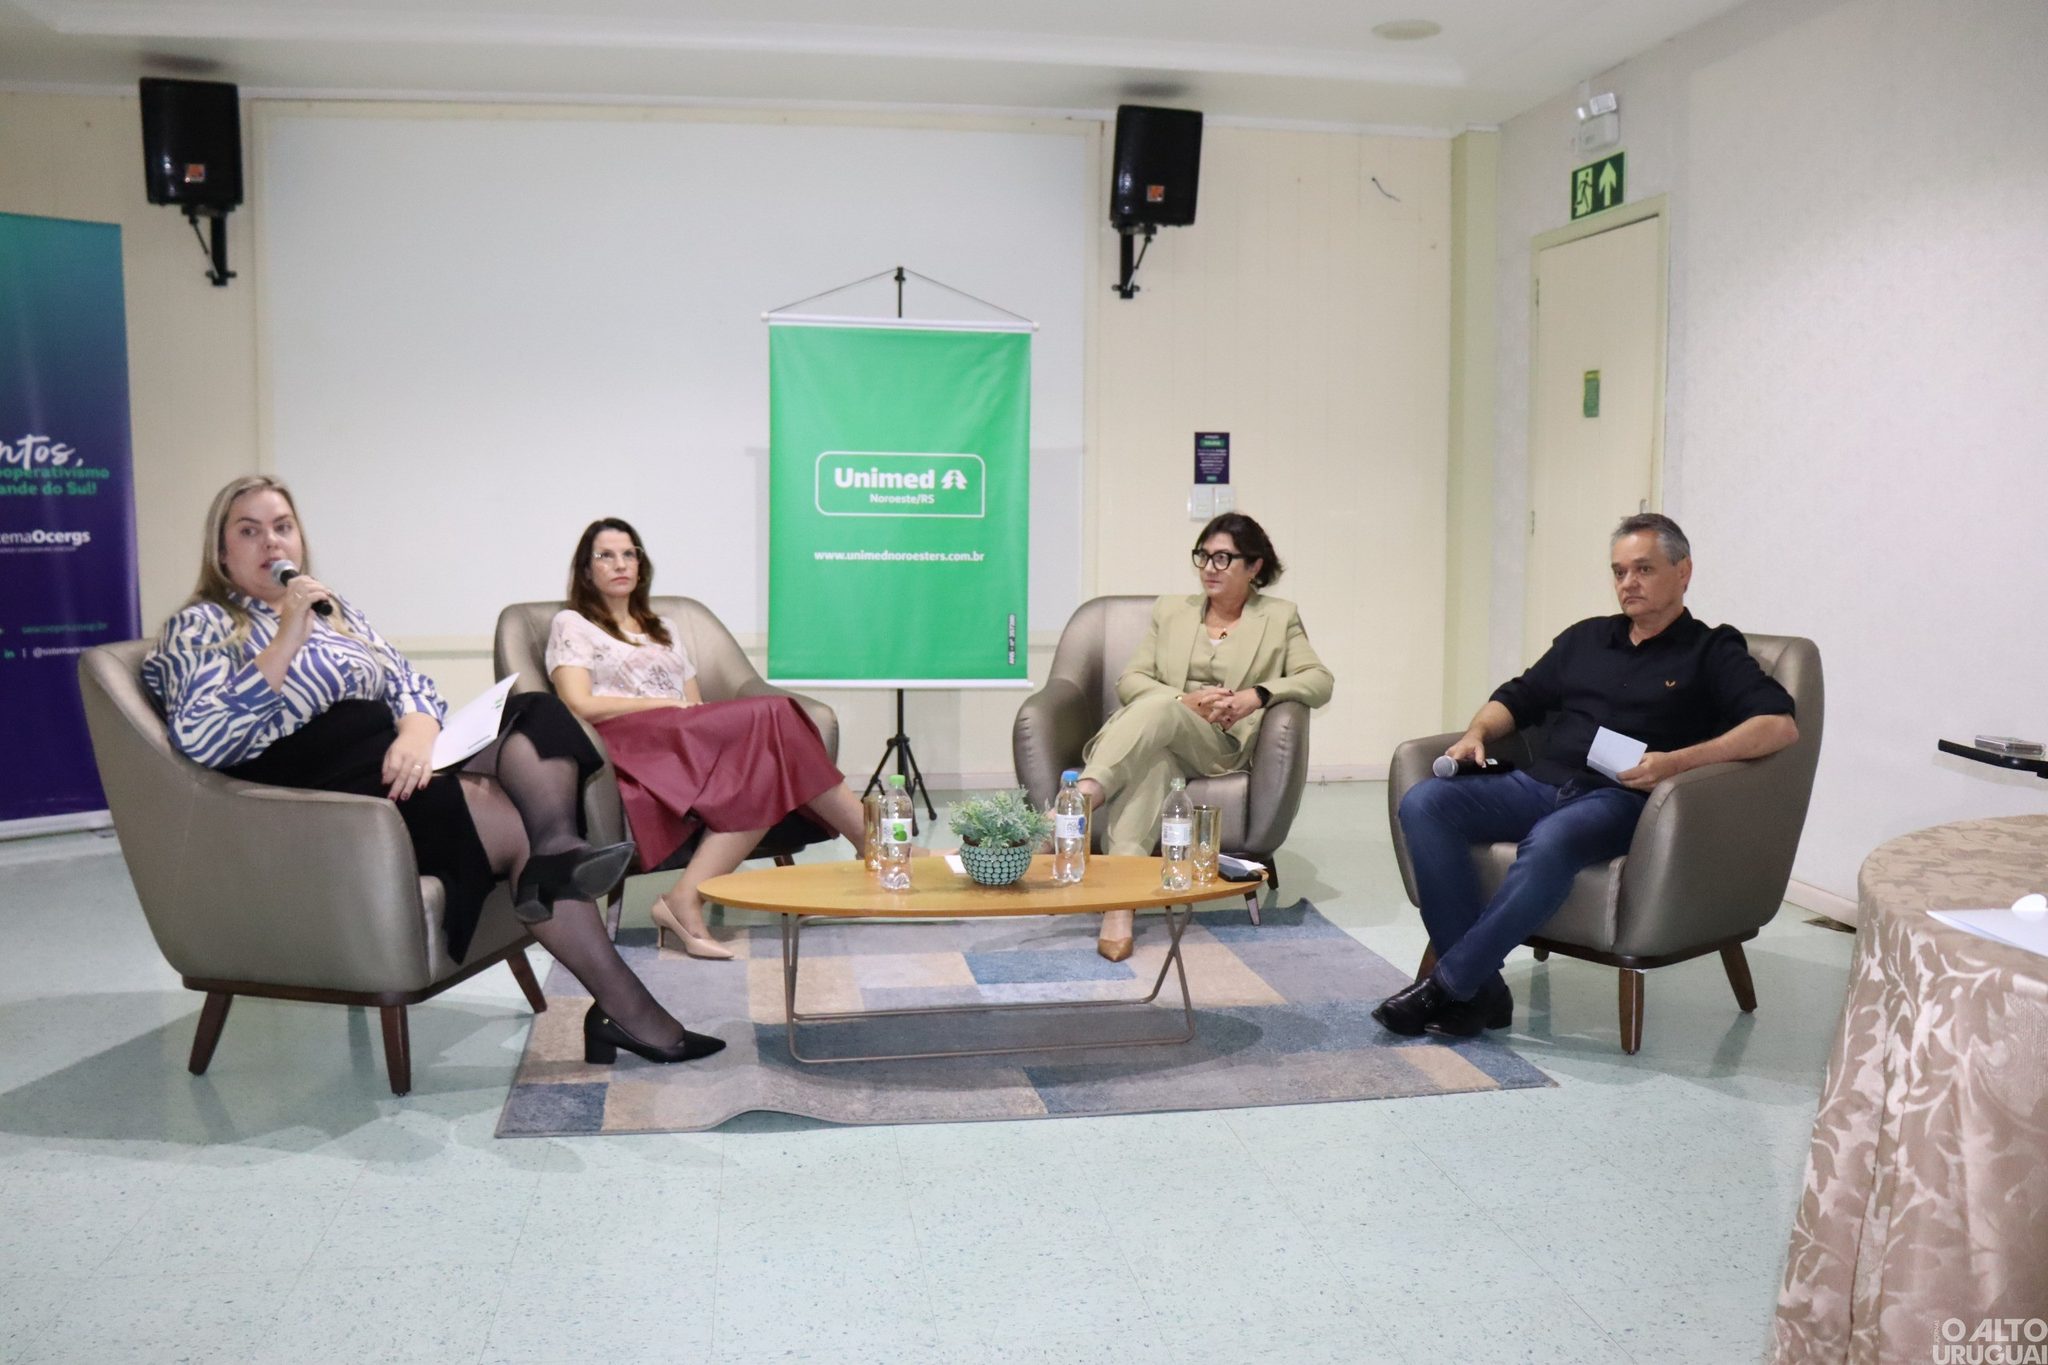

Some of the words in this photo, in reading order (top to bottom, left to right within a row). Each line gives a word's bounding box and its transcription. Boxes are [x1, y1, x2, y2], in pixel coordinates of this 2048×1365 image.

[0, 467, 110, 480] operativismo
[834, 467, 935, 489] Unimed
[42, 481, 63, 495] do
[869, 493, 935, 505] Noroeste/RS
[0, 530, 91, 546] emaOcergs
[814, 550, 984, 562] www.unimednoroesters.com.br
